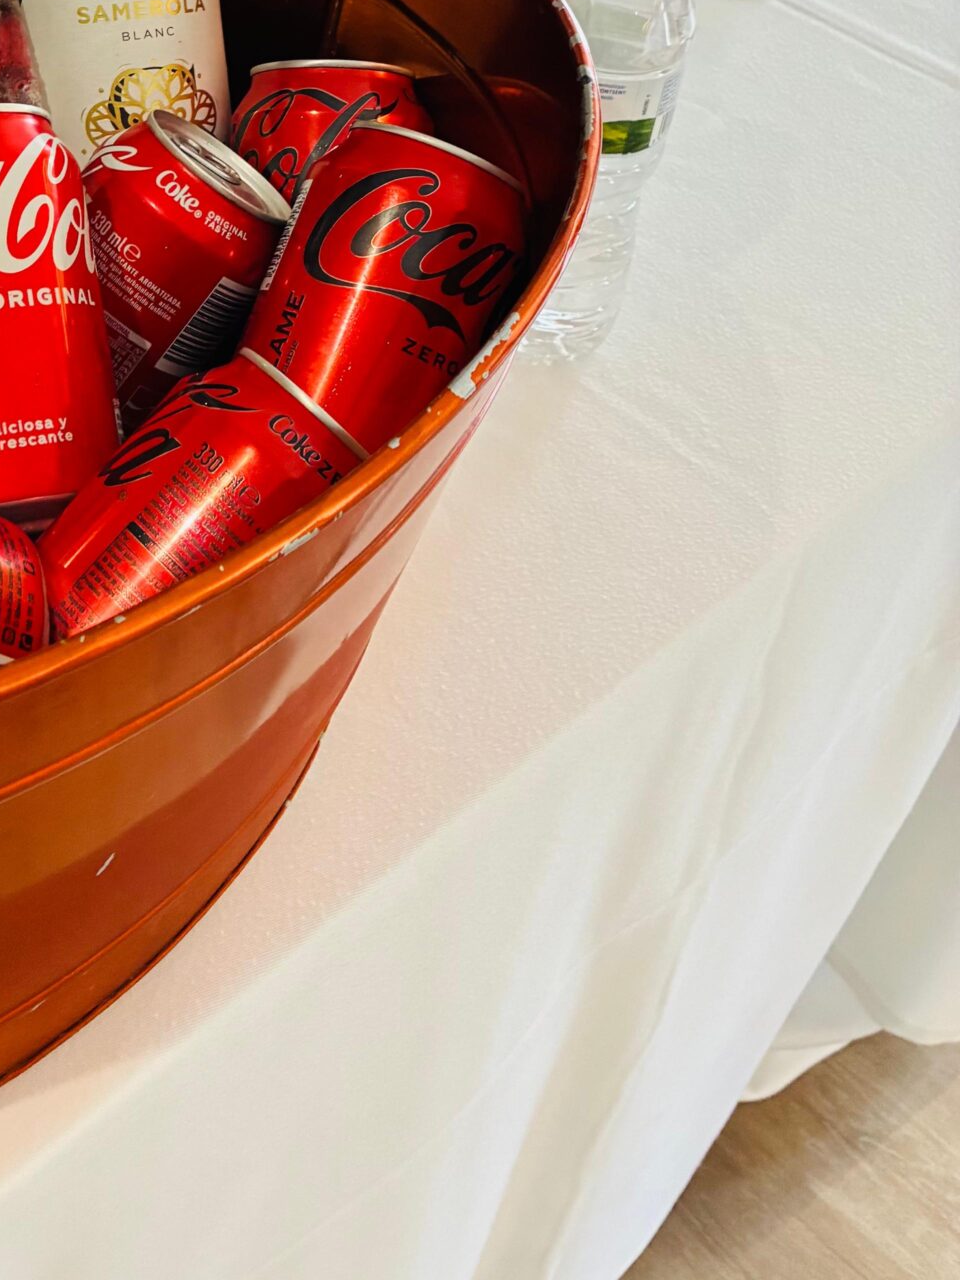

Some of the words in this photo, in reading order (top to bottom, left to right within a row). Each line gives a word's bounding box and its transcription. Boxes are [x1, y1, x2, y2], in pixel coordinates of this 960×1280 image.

[121, 26, 176, 42] BLANC
[155, 170, 201, 213] Coke
[90, 210, 113, 236] 330
[204, 218, 233, 241] TASTE
[206, 210, 248, 241] ORIGINAL
[101, 241, 139, 277] REFRESCANTE
[400, 336, 462, 374] ZERO
[58, 417, 67, 430] y
[268, 414, 321, 467] Coke
[193, 441, 224, 474] 330
